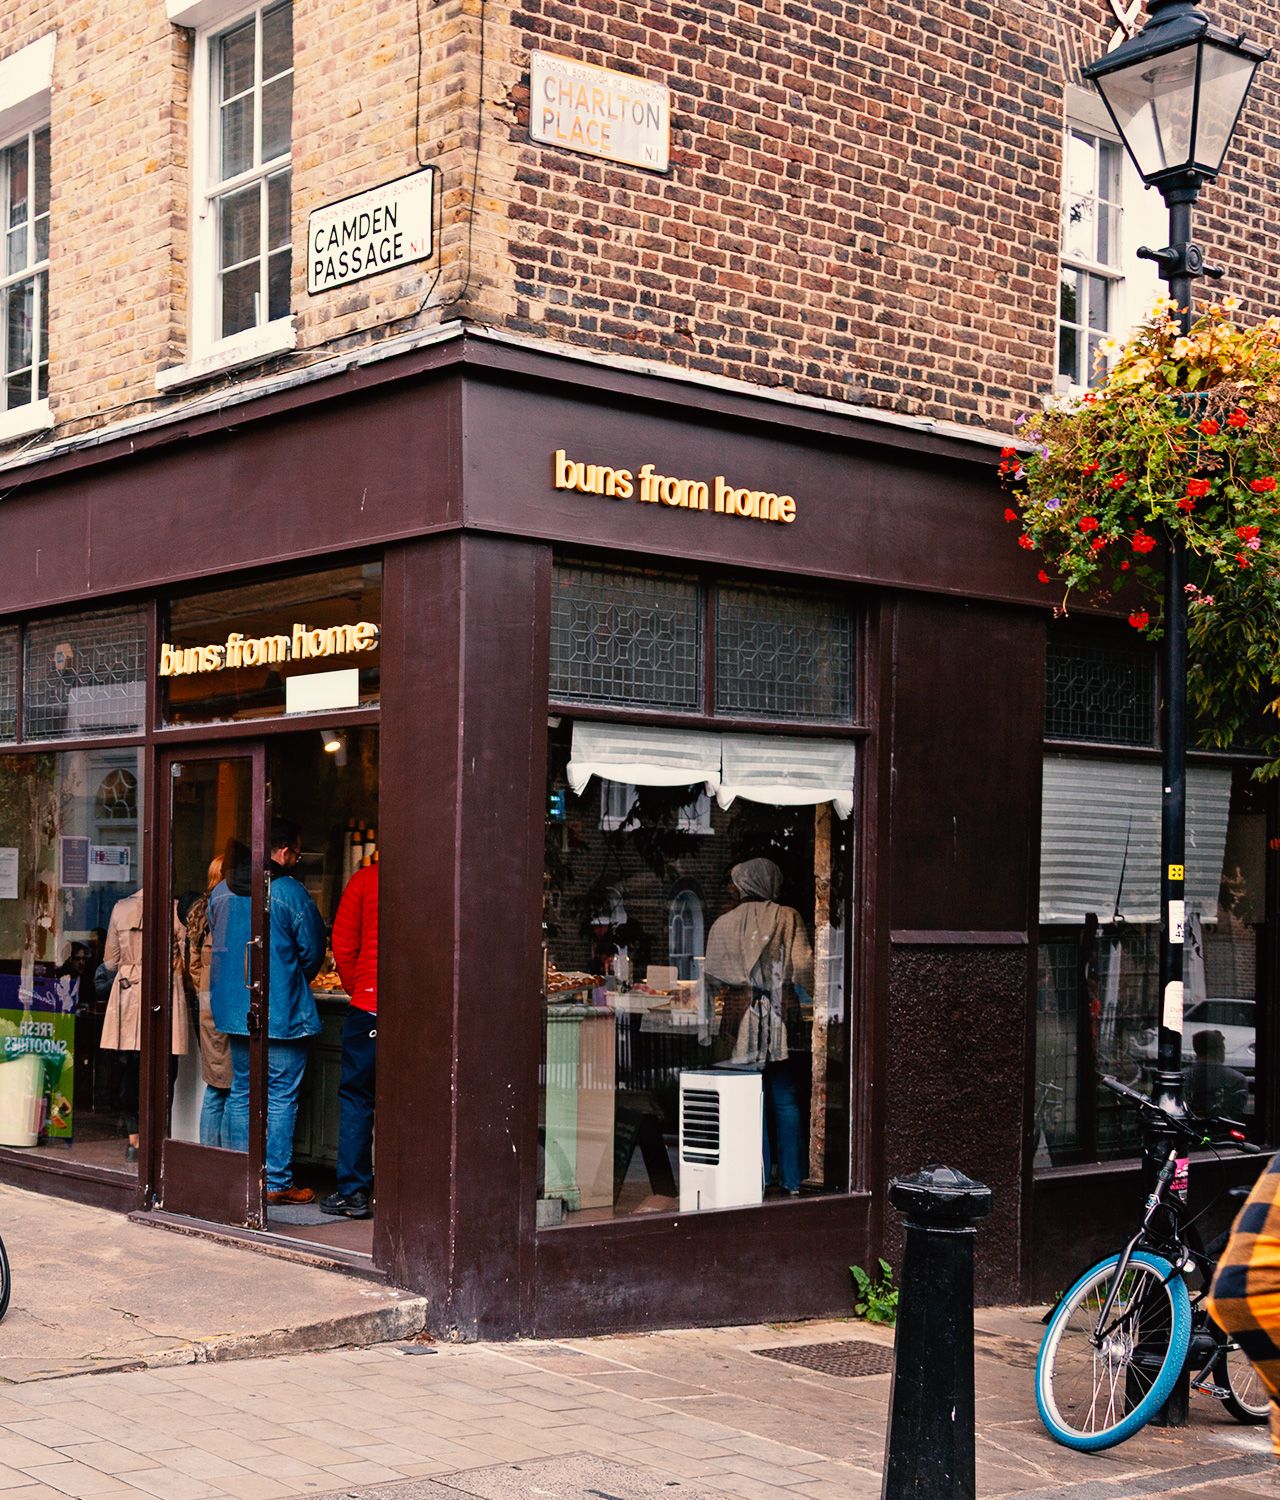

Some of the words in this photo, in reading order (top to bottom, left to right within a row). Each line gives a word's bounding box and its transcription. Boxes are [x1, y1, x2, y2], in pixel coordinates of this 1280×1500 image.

[536, 57, 568, 75] LONDON
[572, 68, 608, 84] BOROUGH
[627, 80, 666, 101] ISLINGTON
[543, 75, 660, 131] CHARLTON
[542, 107, 612, 151] PLACE
[314, 201, 398, 254] CAMDEN
[314, 232, 404, 286] PASSAGE
[555, 449, 634, 499] buns
[638, 464, 709, 510] from
[714, 475, 797, 523] home
[159, 643, 224, 676] buns
[225, 632, 291, 668] from
[292, 621, 379, 659] home
